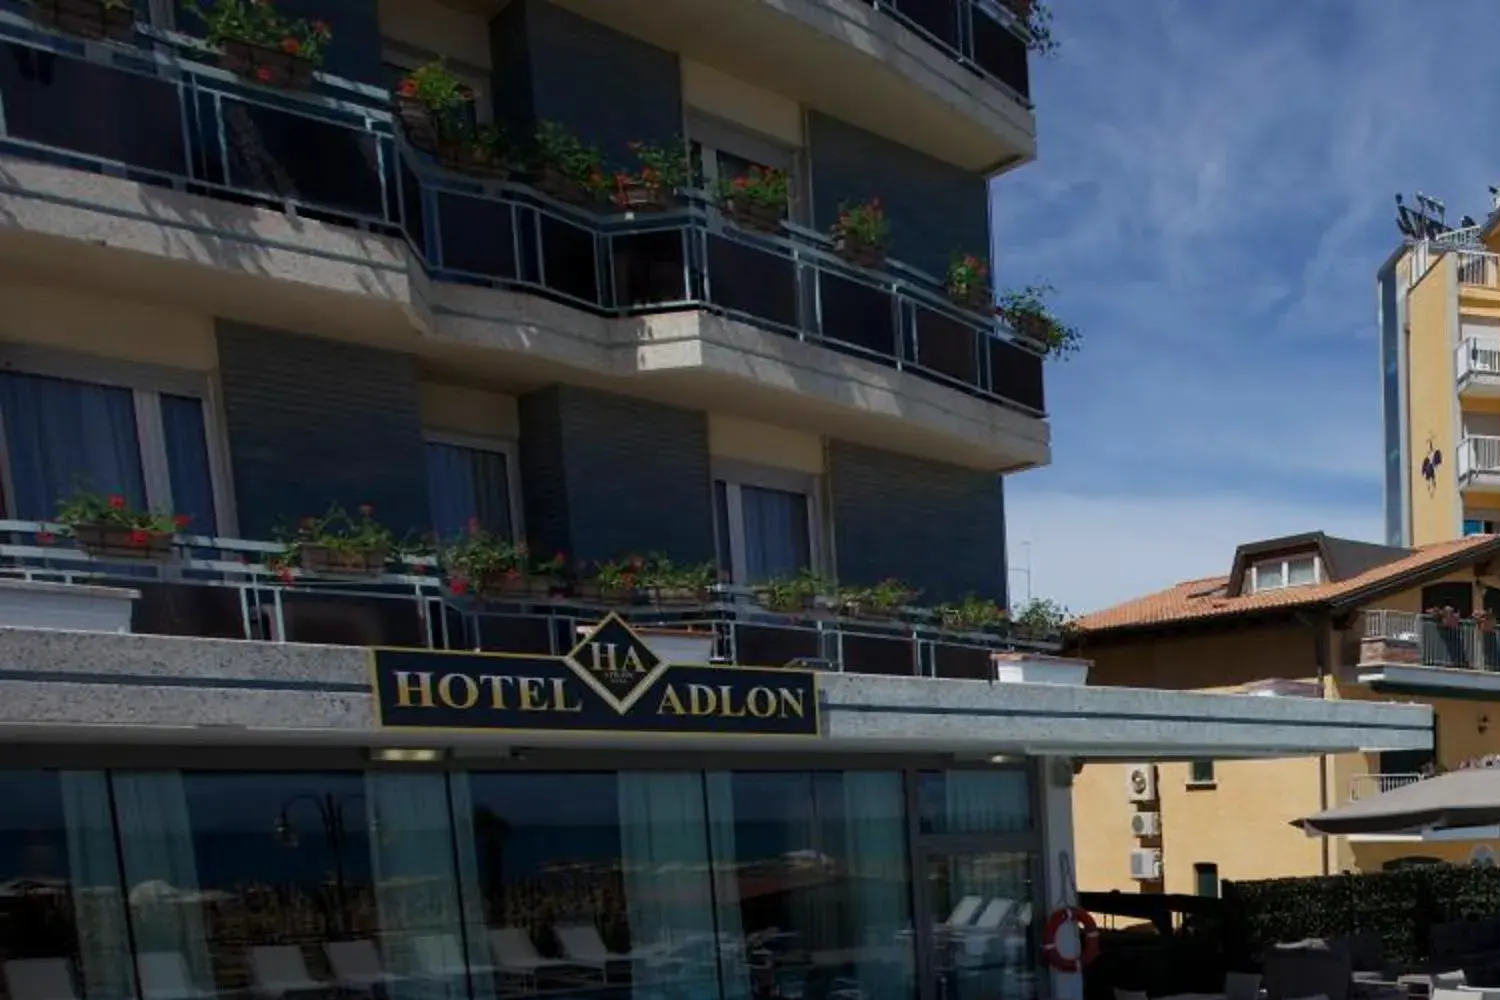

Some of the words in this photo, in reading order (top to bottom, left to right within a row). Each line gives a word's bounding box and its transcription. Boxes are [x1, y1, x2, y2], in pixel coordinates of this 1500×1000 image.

[590, 642, 646, 673] HA
[393, 671, 584, 713] HOTEL
[656, 683, 805, 719] ADLON
